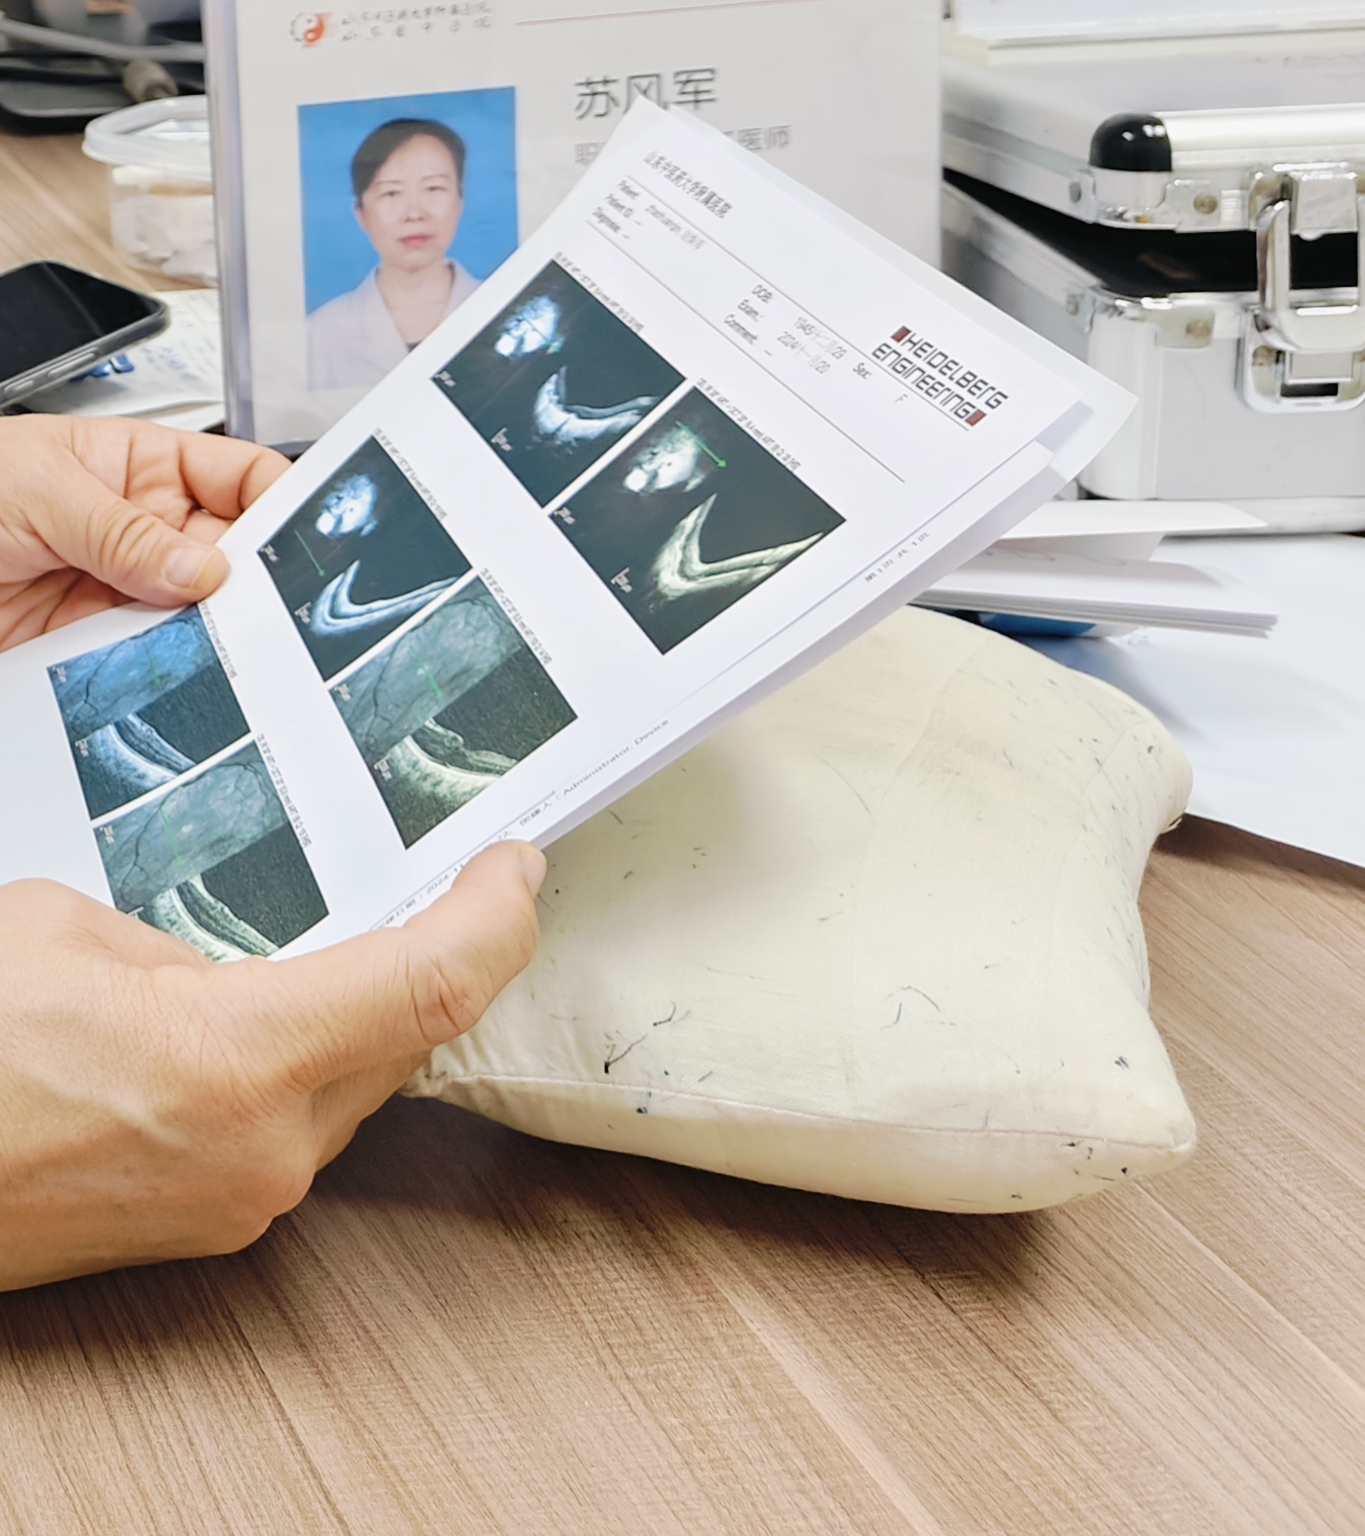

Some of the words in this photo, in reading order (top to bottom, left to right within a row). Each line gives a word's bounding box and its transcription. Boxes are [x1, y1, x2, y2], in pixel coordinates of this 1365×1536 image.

[573, 67, 717, 120] 苏风军
[871, 342, 975, 420] ENGINEERING
[901, 332, 1009, 410] HEIDELBERG
